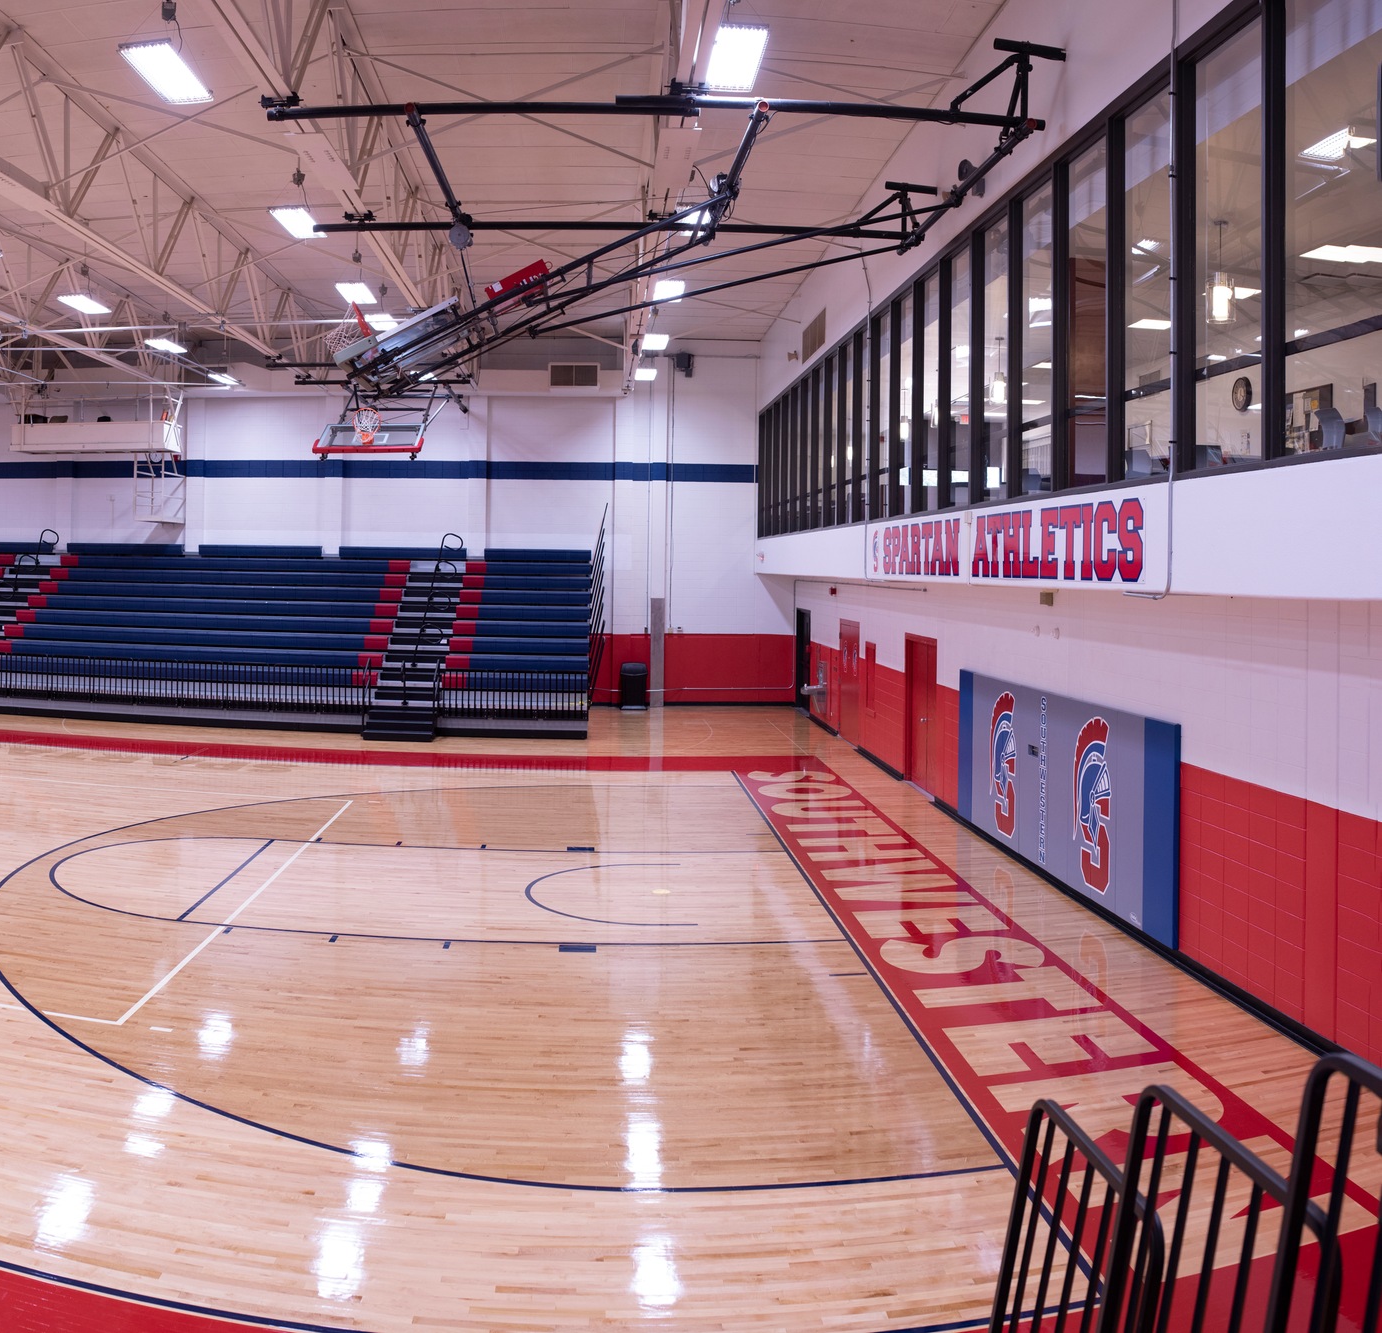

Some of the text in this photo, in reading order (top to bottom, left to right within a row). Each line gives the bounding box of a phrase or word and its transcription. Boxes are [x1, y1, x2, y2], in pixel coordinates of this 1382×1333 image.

[883, 498, 1144, 582] SPARTAN ATHLETICS
[1039, 696, 1048, 864] SOUTHWESTERN
